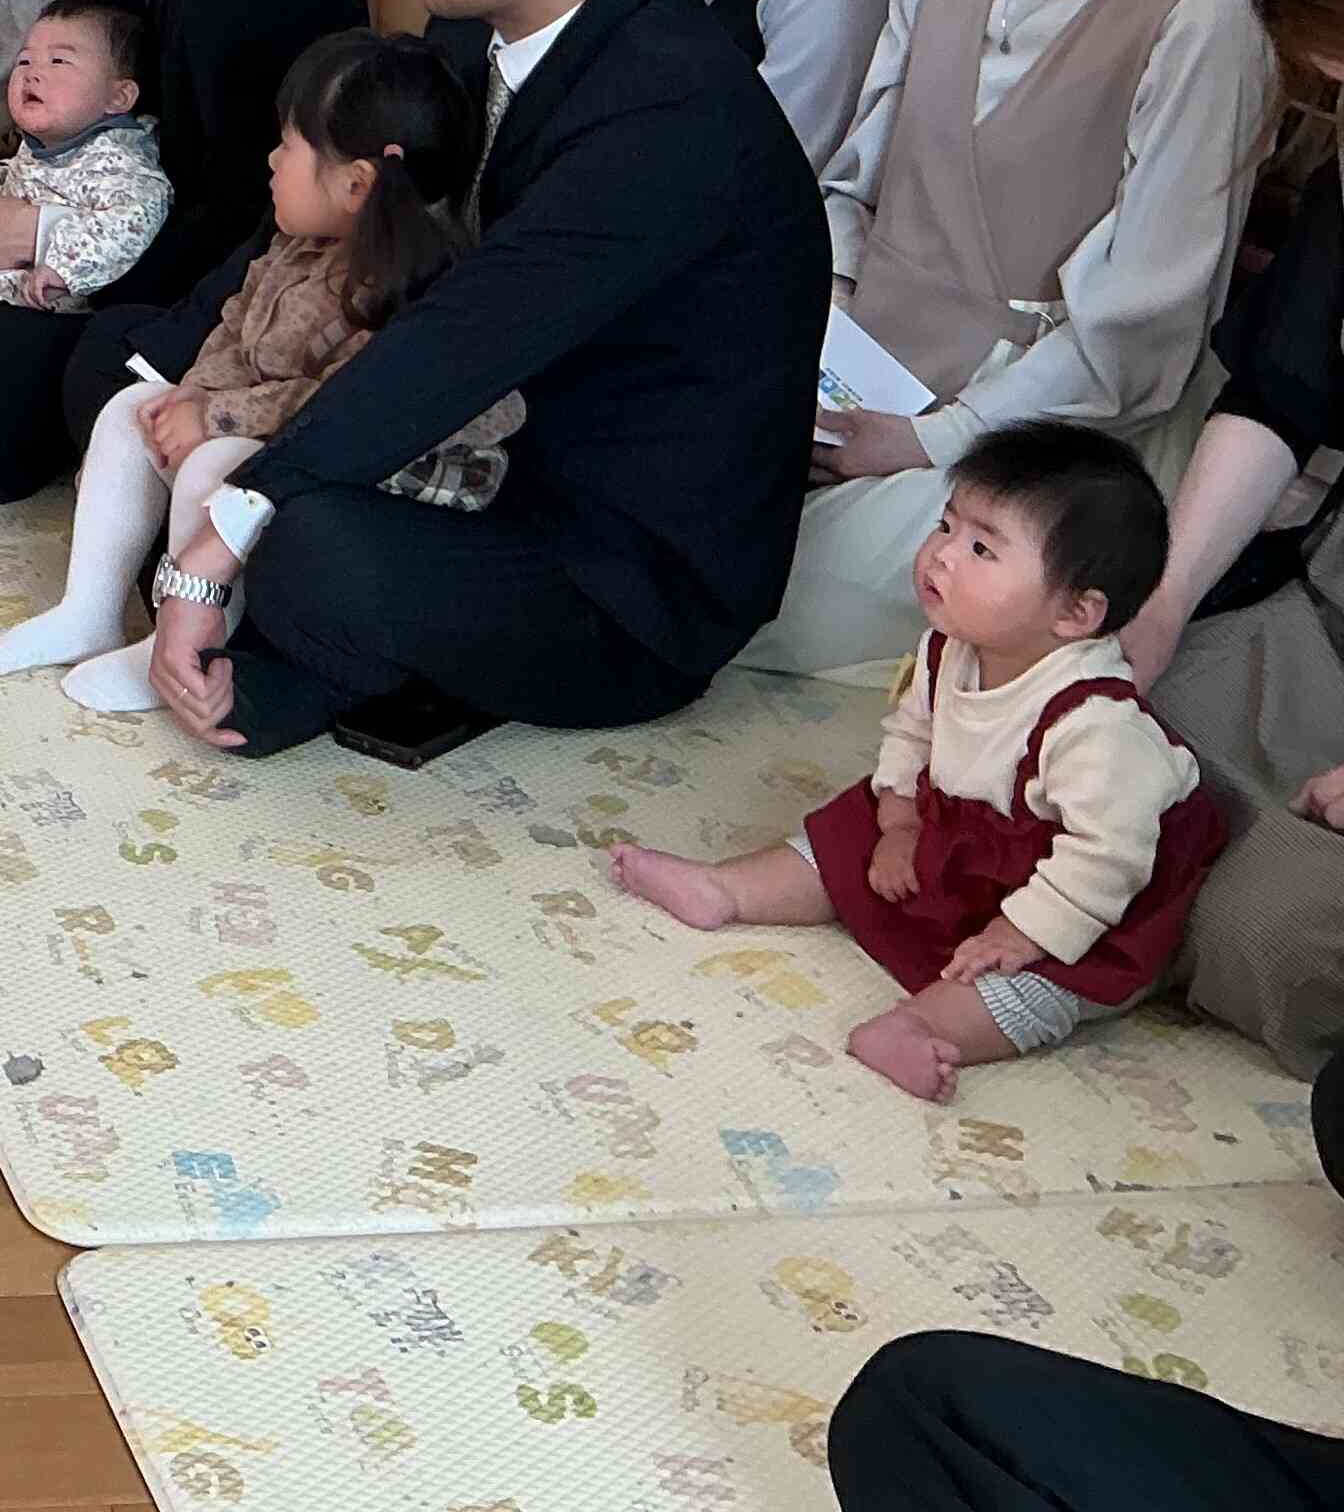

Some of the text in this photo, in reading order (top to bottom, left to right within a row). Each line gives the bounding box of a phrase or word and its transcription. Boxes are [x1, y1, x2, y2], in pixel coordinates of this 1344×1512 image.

[118, 842, 178, 866] S
[316, 865, 375, 892] G
[53, 904, 115, 935] R
[391, 1018, 456, 1052] D
[172, 1149, 238, 1179] E
[408, 1140, 479, 1186] M
[516, 1383, 599, 1426] S
[172, 1451, 246, 1505] G
